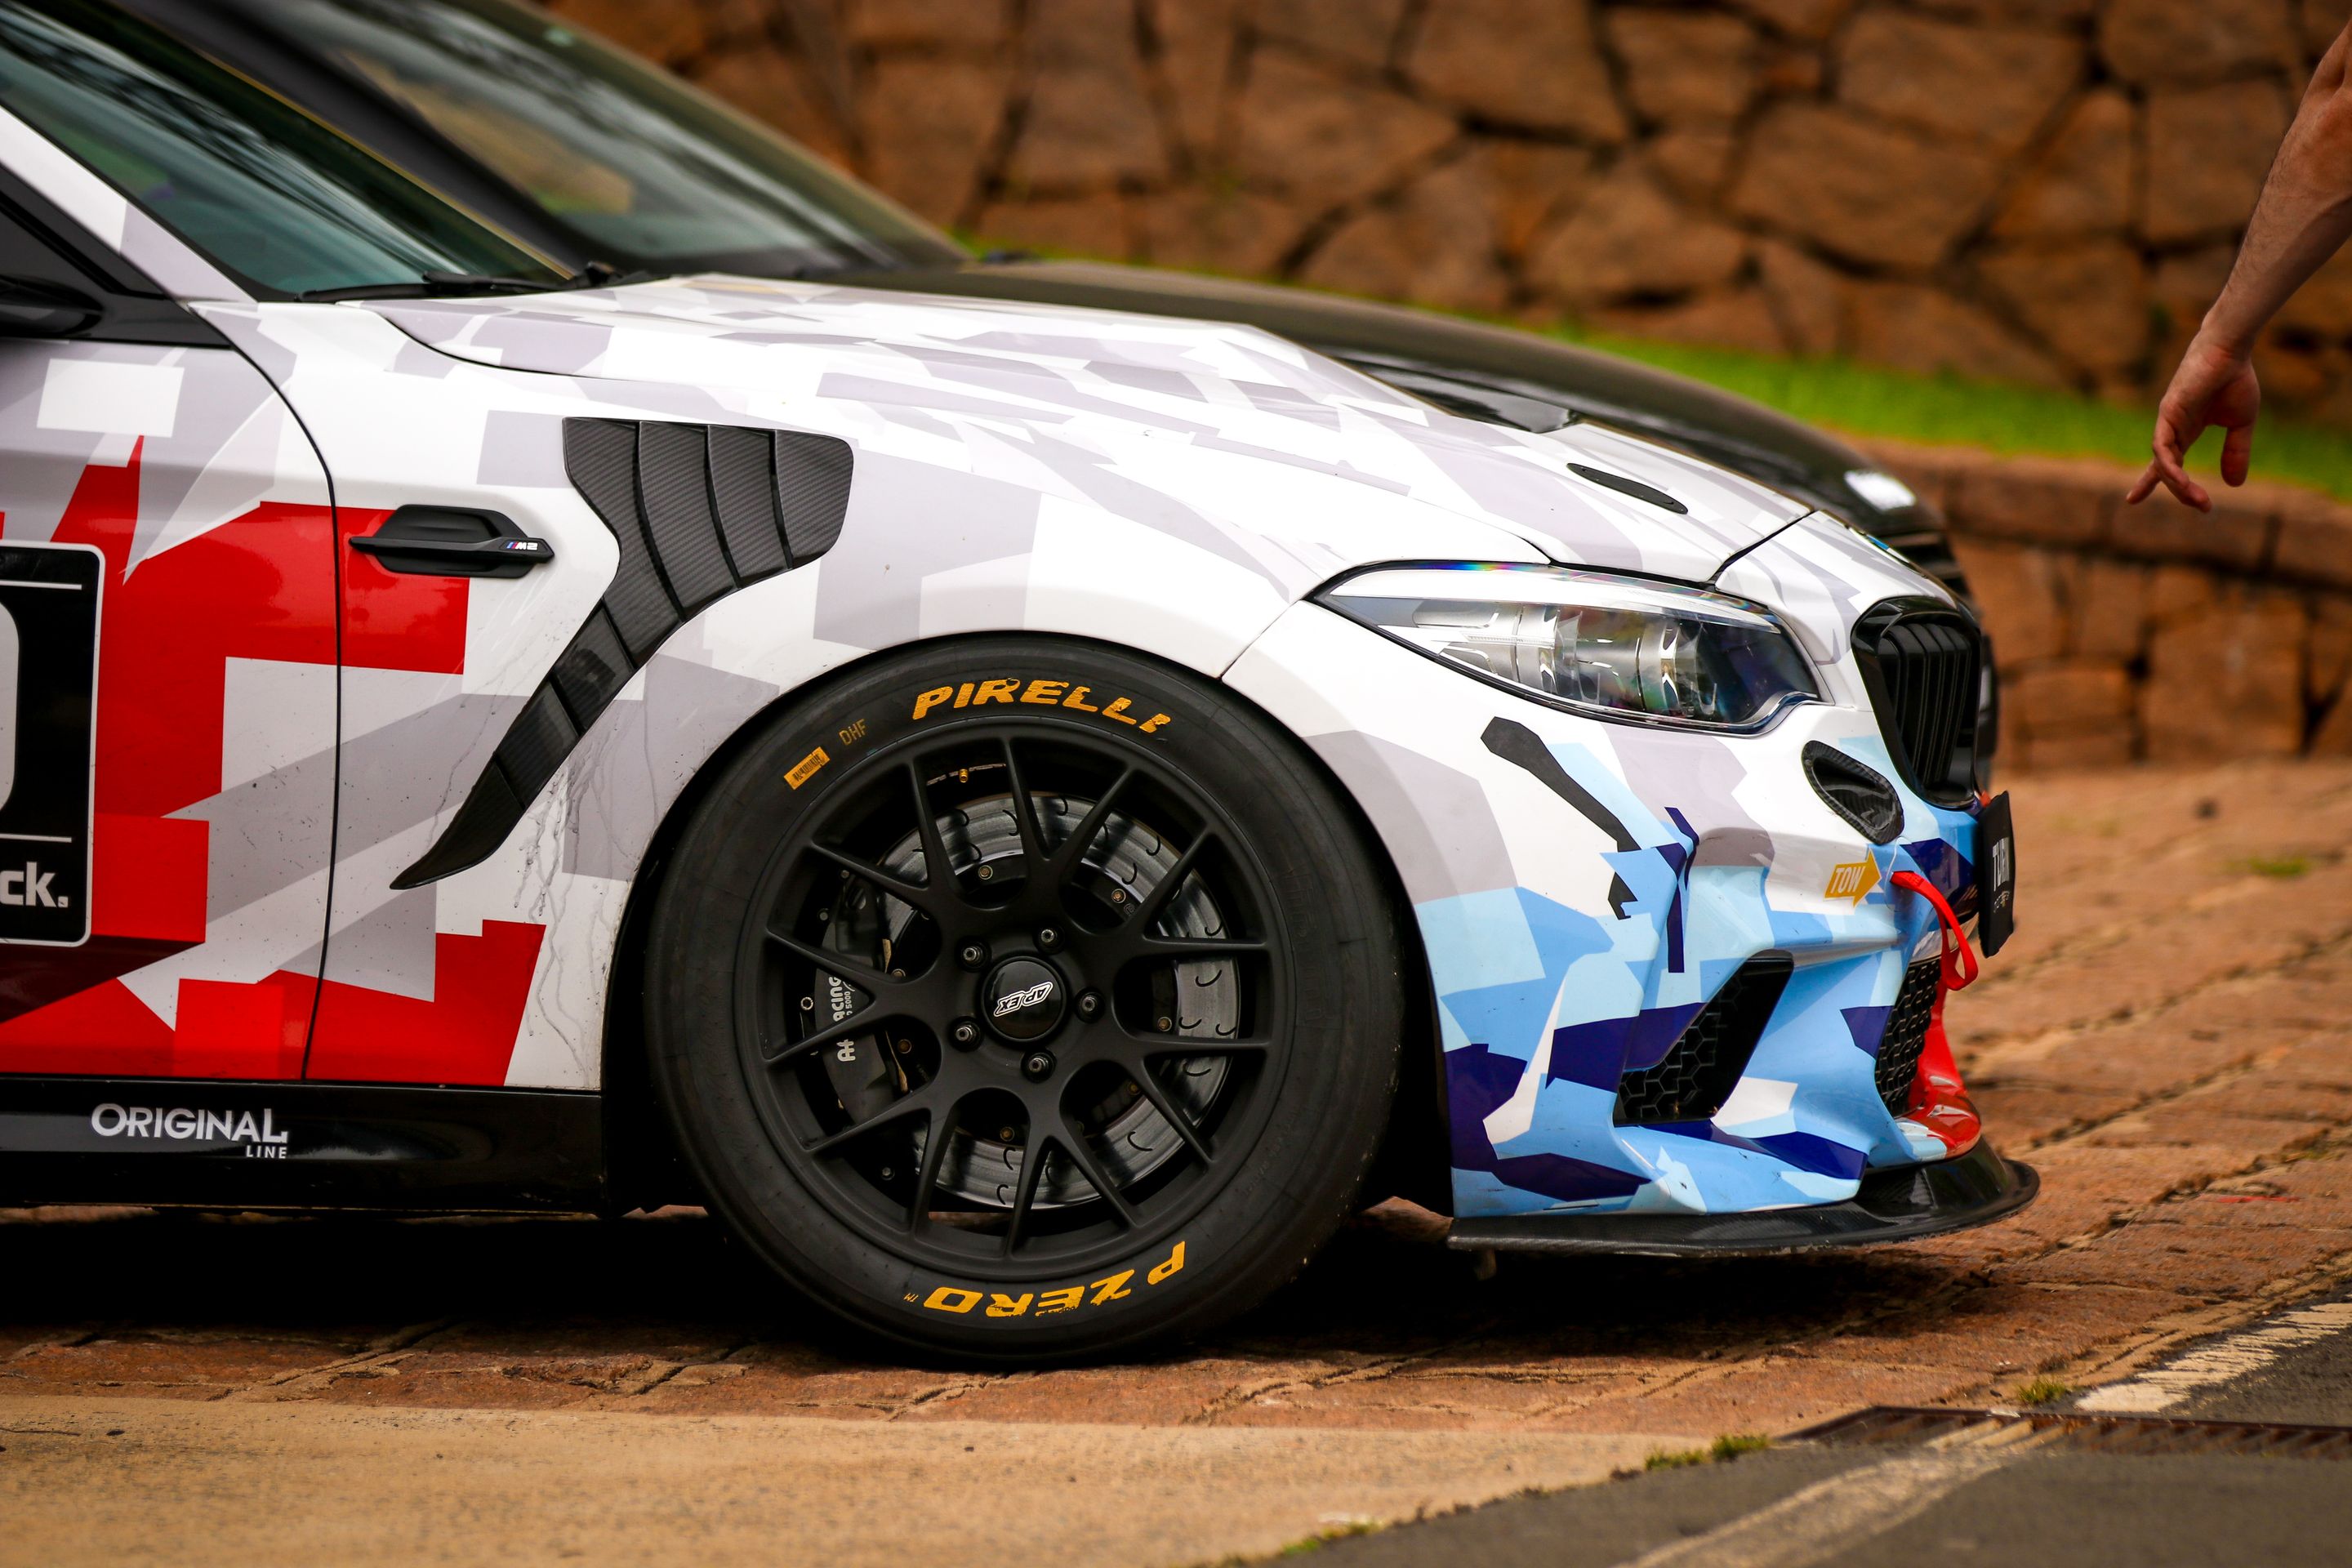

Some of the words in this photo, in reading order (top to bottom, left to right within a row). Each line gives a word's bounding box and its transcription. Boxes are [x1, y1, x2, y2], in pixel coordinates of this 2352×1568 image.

[511, 541, 539, 551] M2
[912, 677, 1172, 733] PIRELLI
[1830, 866, 1866, 893] TOW
[993, 981, 1054, 1018] APEX
[91, 1102, 288, 1144] ORIGINAL
[246, 1146, 287, 1159] LINE
[1147, 1241, 1187, 1285] P
[923, 1268, 1136, 1317] ZERO
